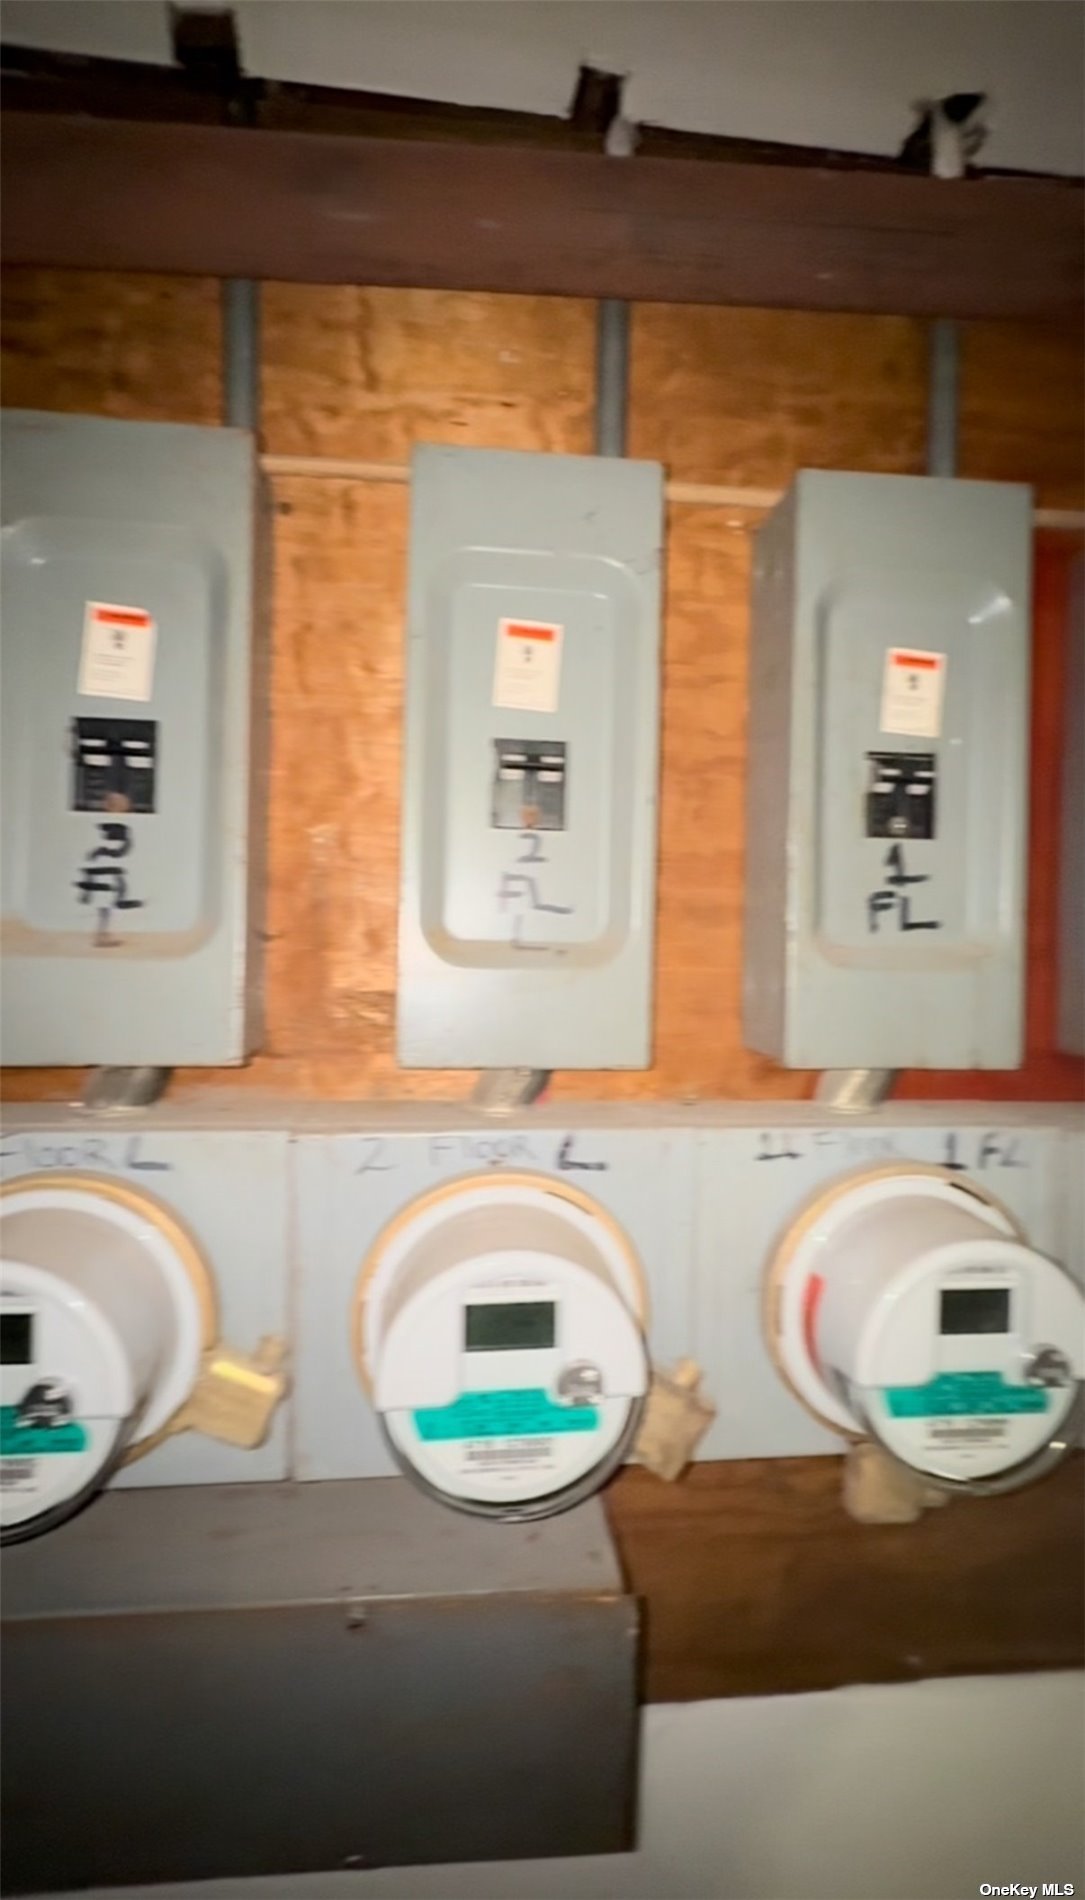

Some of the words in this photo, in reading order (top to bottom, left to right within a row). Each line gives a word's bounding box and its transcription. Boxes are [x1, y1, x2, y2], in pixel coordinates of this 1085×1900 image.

[516, 833, 549, 863] 2
[885, 843, 931, 887] 1
[498, 873, 574, 914] FL
[868, 890, 942, 933] FL
[355, 1137, 396, 1174] 2
[557, 1132, 608, 1170] L
